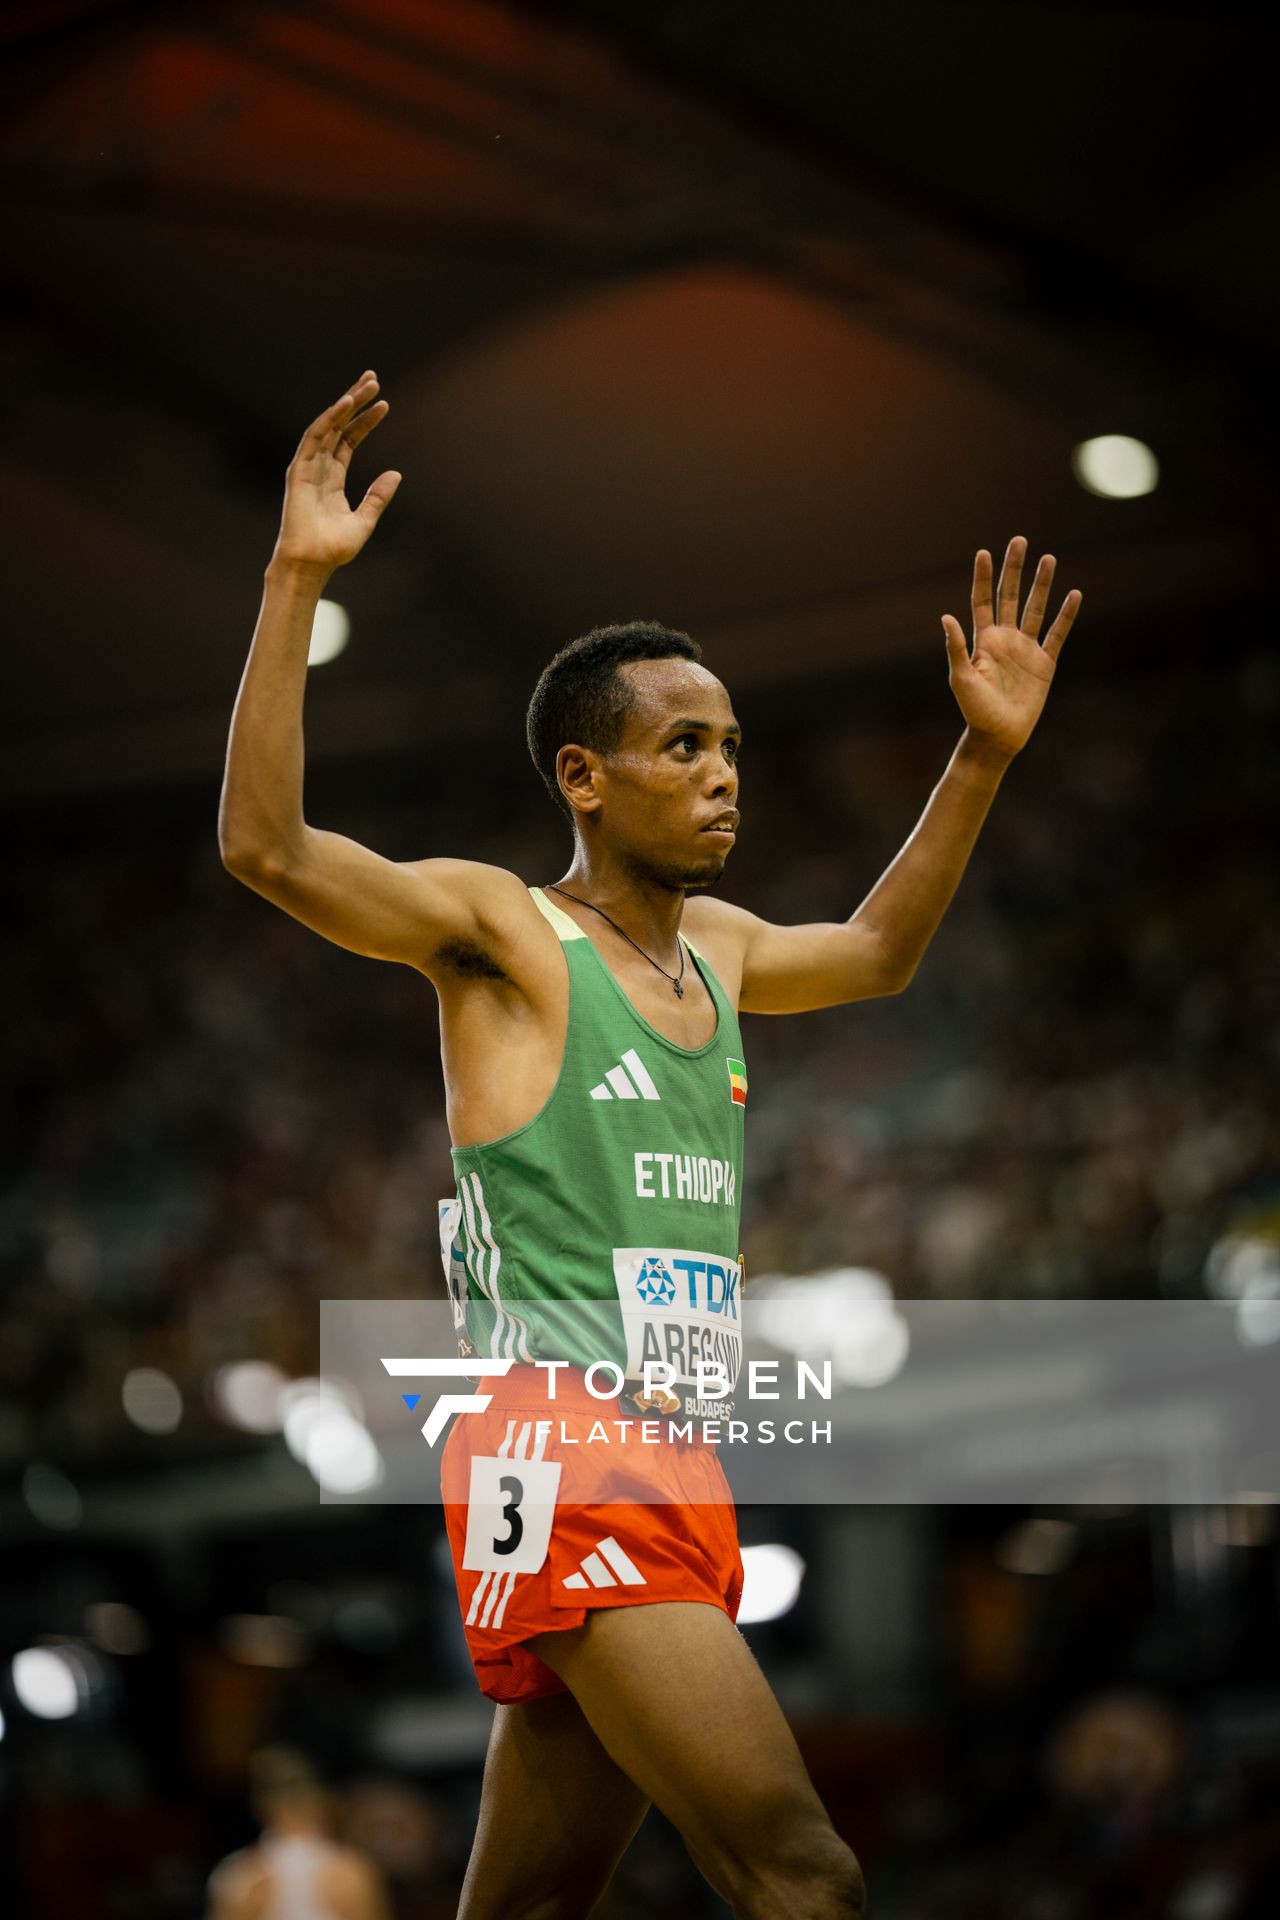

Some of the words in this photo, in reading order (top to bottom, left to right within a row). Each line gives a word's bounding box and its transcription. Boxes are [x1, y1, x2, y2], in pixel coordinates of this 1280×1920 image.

[634, 1152, 736, 1207] ETHIOPIA
[672, 1258, 739, 1320] TDK
[685, 1396, 731, 1422] BUDAPES
[492, 1475, 524, 1556] 3
